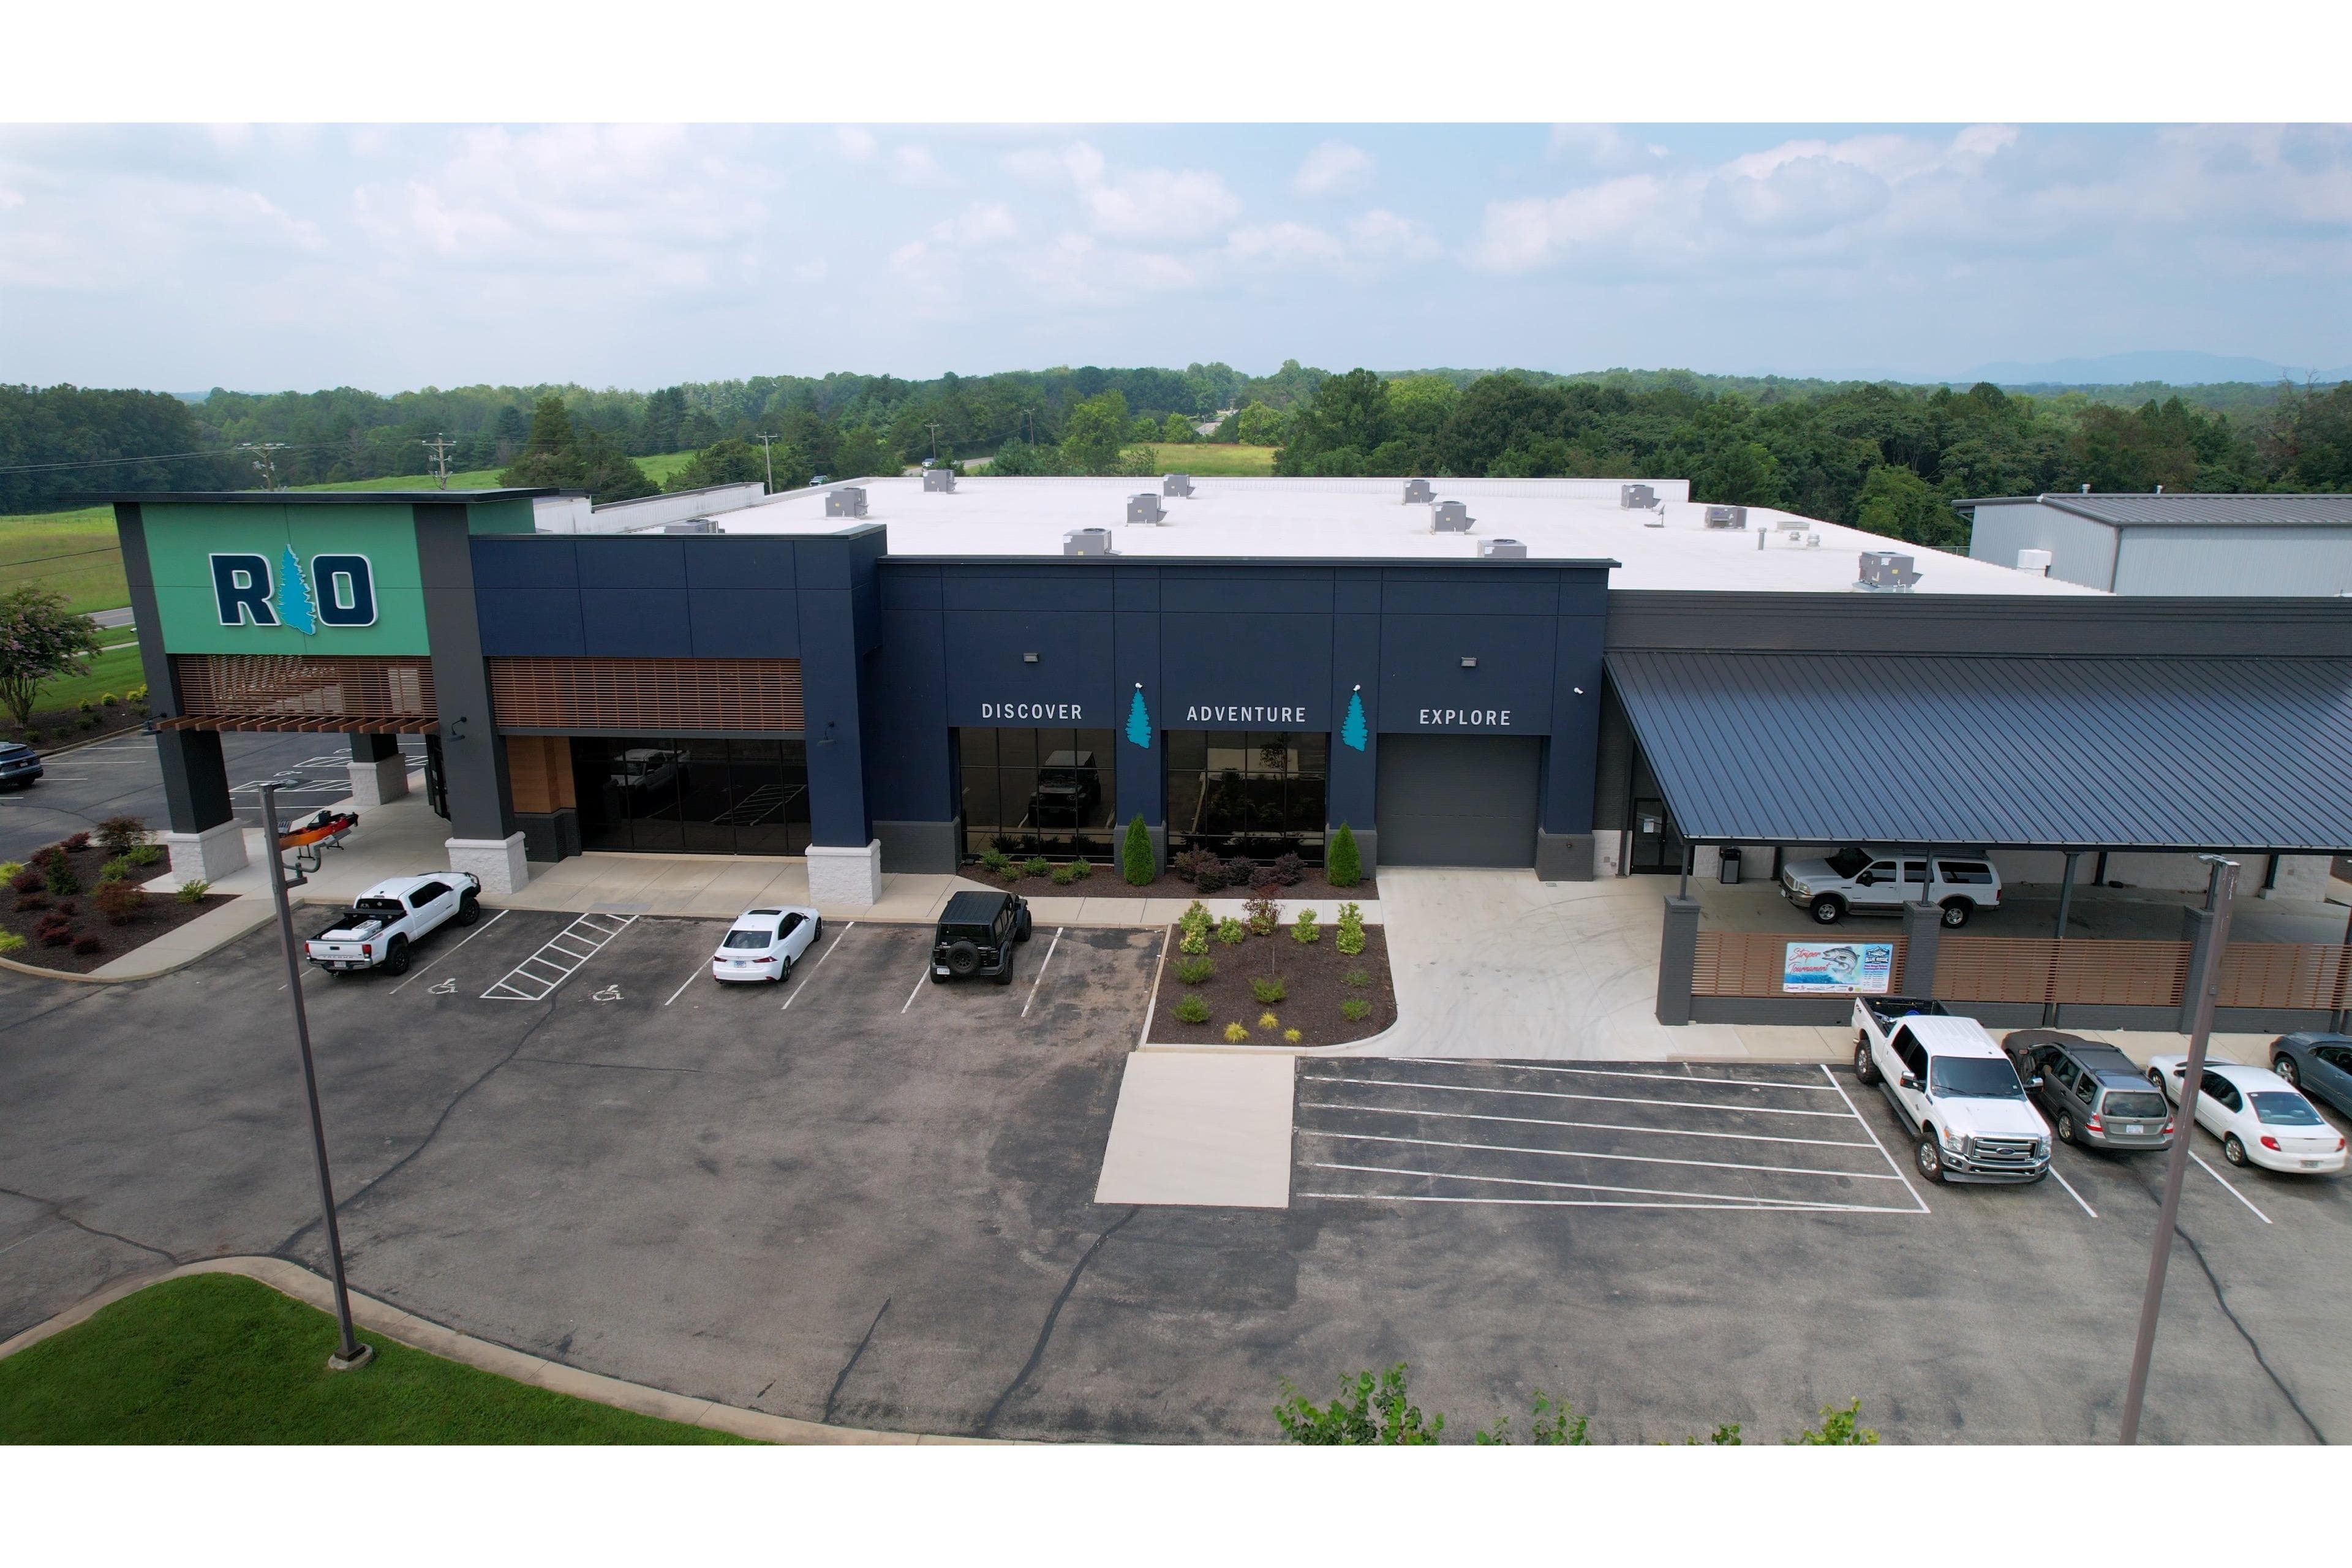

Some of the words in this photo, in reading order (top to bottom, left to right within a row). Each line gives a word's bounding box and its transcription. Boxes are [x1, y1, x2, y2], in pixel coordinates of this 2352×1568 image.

[981, 703, 1082, 720] DISCOVER
[1186, 706, 1306, 723] ADVENTURE
[1419, 709, 1511, 726] EXPLORE
[1789, 947, 1821, 963] Striper
[1788, 962, 1833, 975] Tournament
